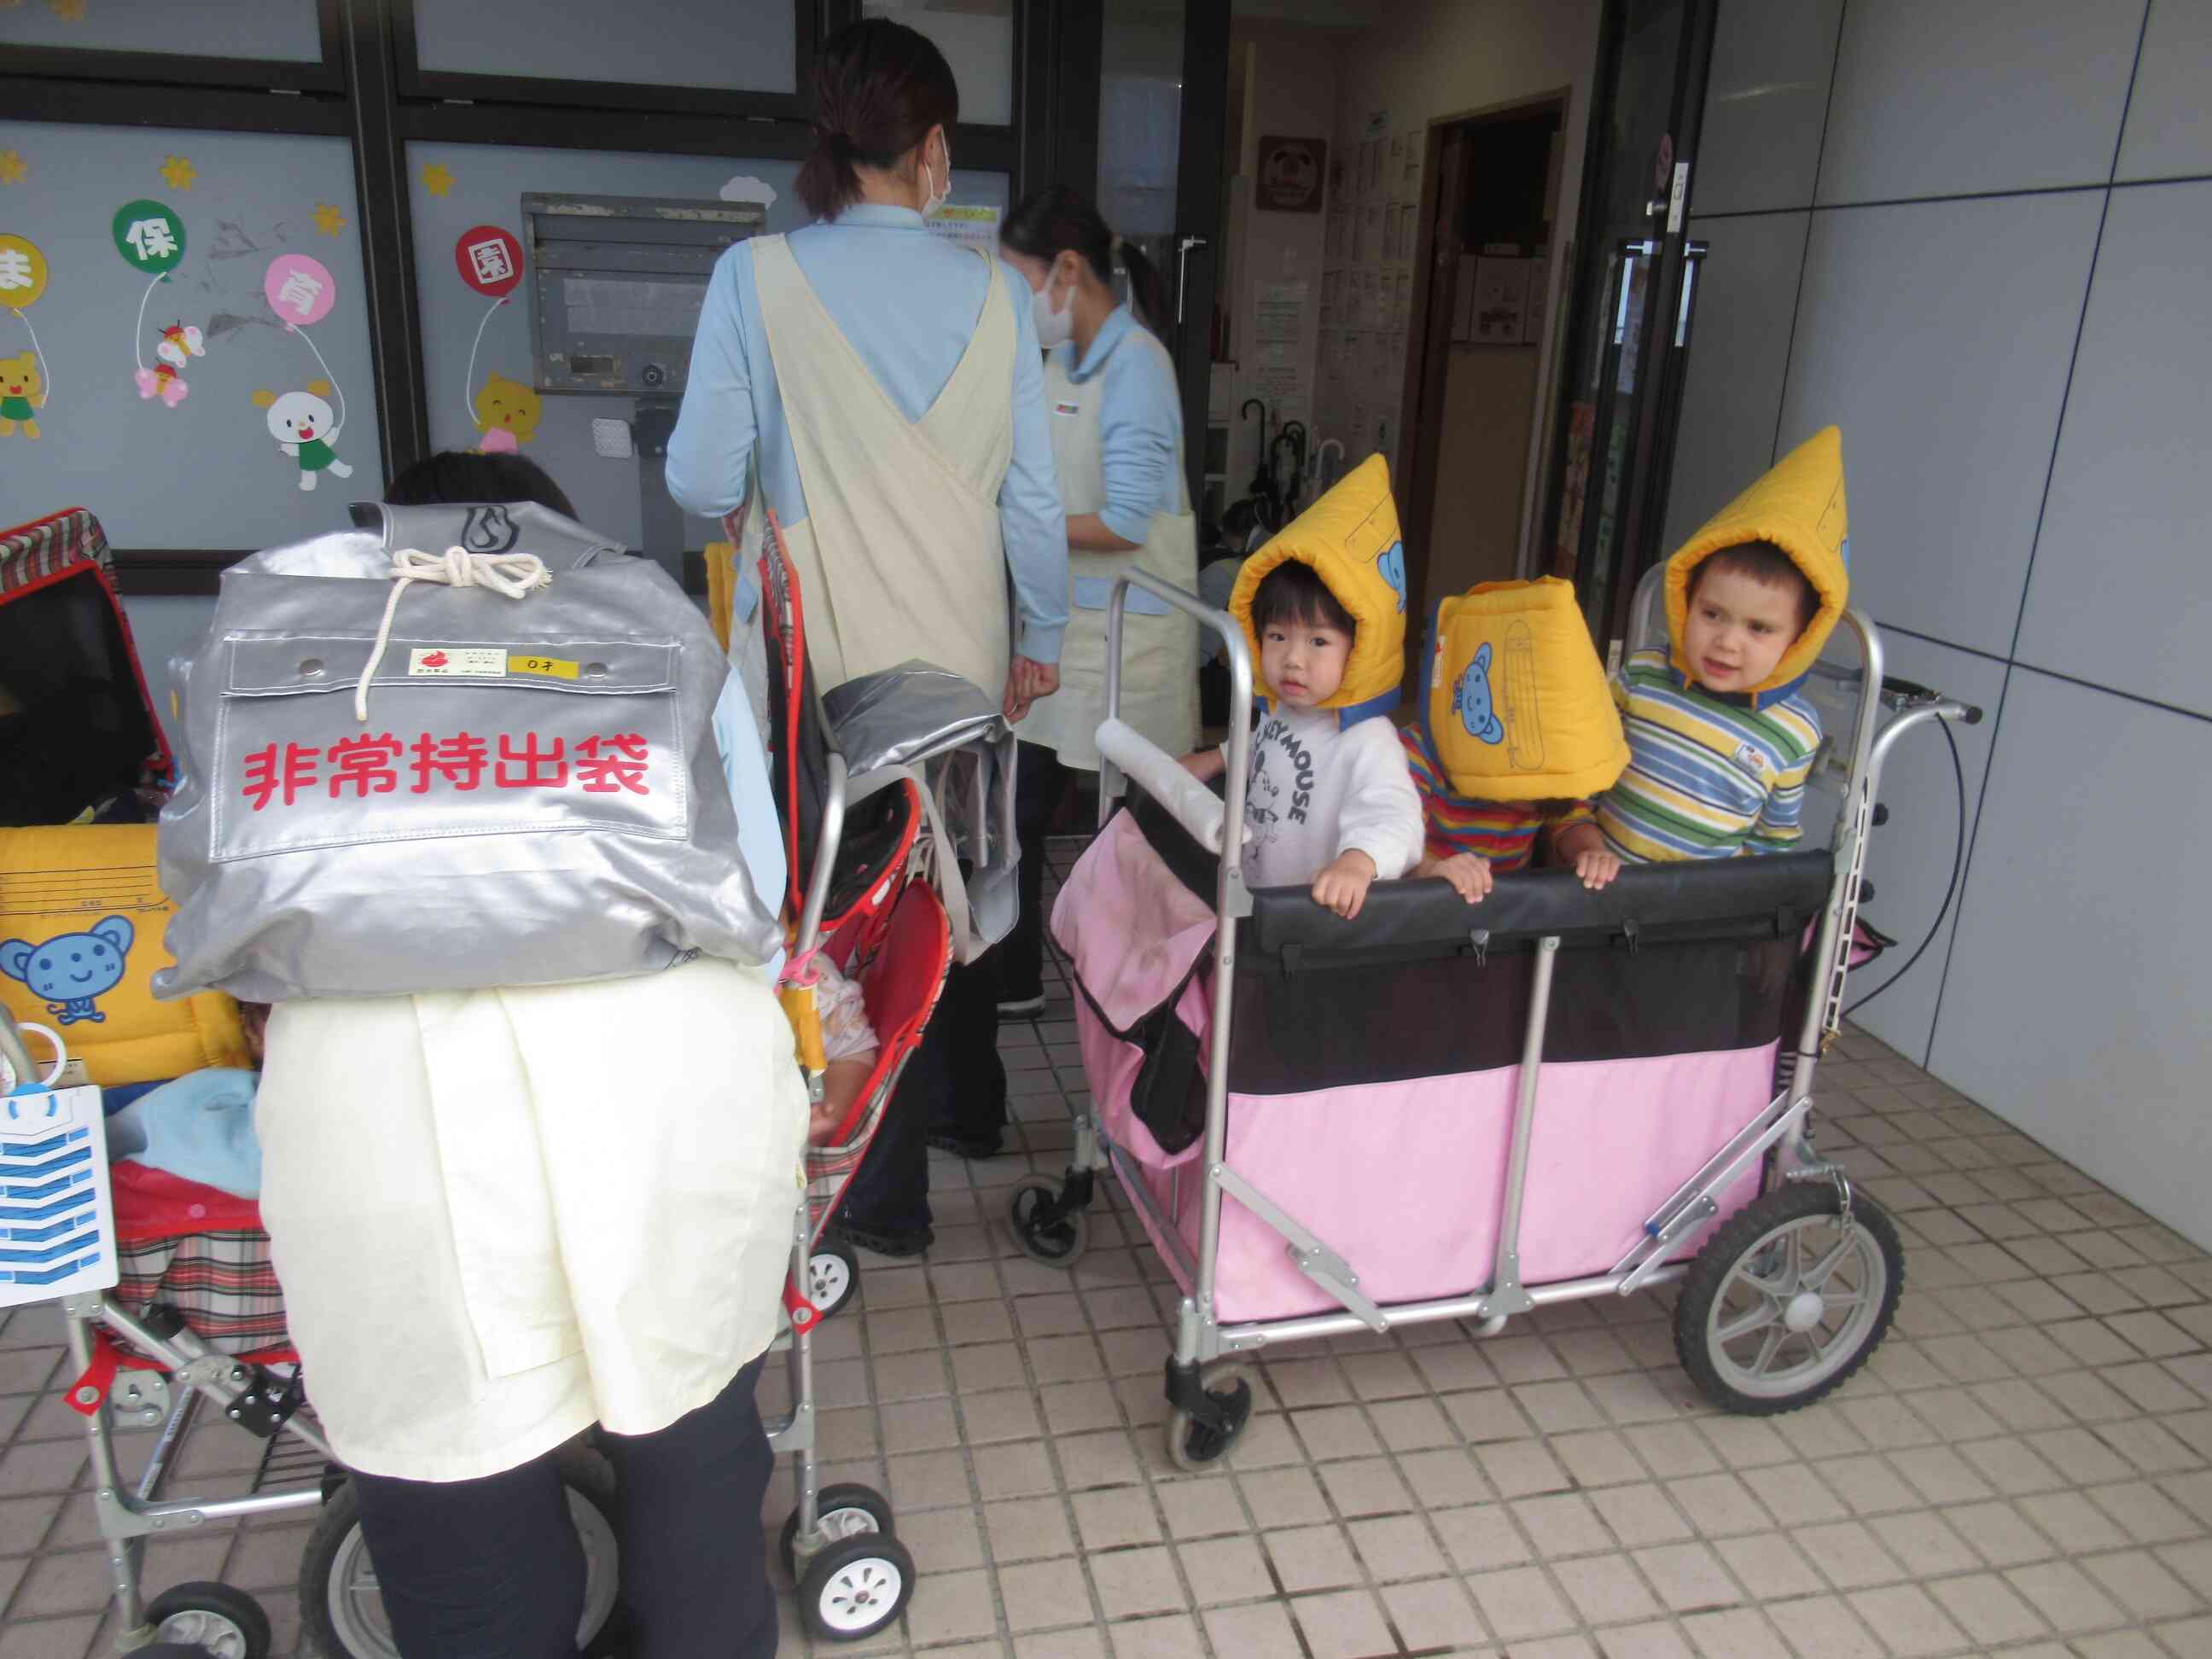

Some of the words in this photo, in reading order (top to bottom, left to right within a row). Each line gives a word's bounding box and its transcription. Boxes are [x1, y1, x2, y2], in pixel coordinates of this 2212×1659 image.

[125, 218, 178, 260] 保
[279, 268, 323, 315] 育
[468, 238, 514, 284] 園
[242, 731, 649, 811] 非常持出袋
[1280, 733, 1314, 825] MOUSE
